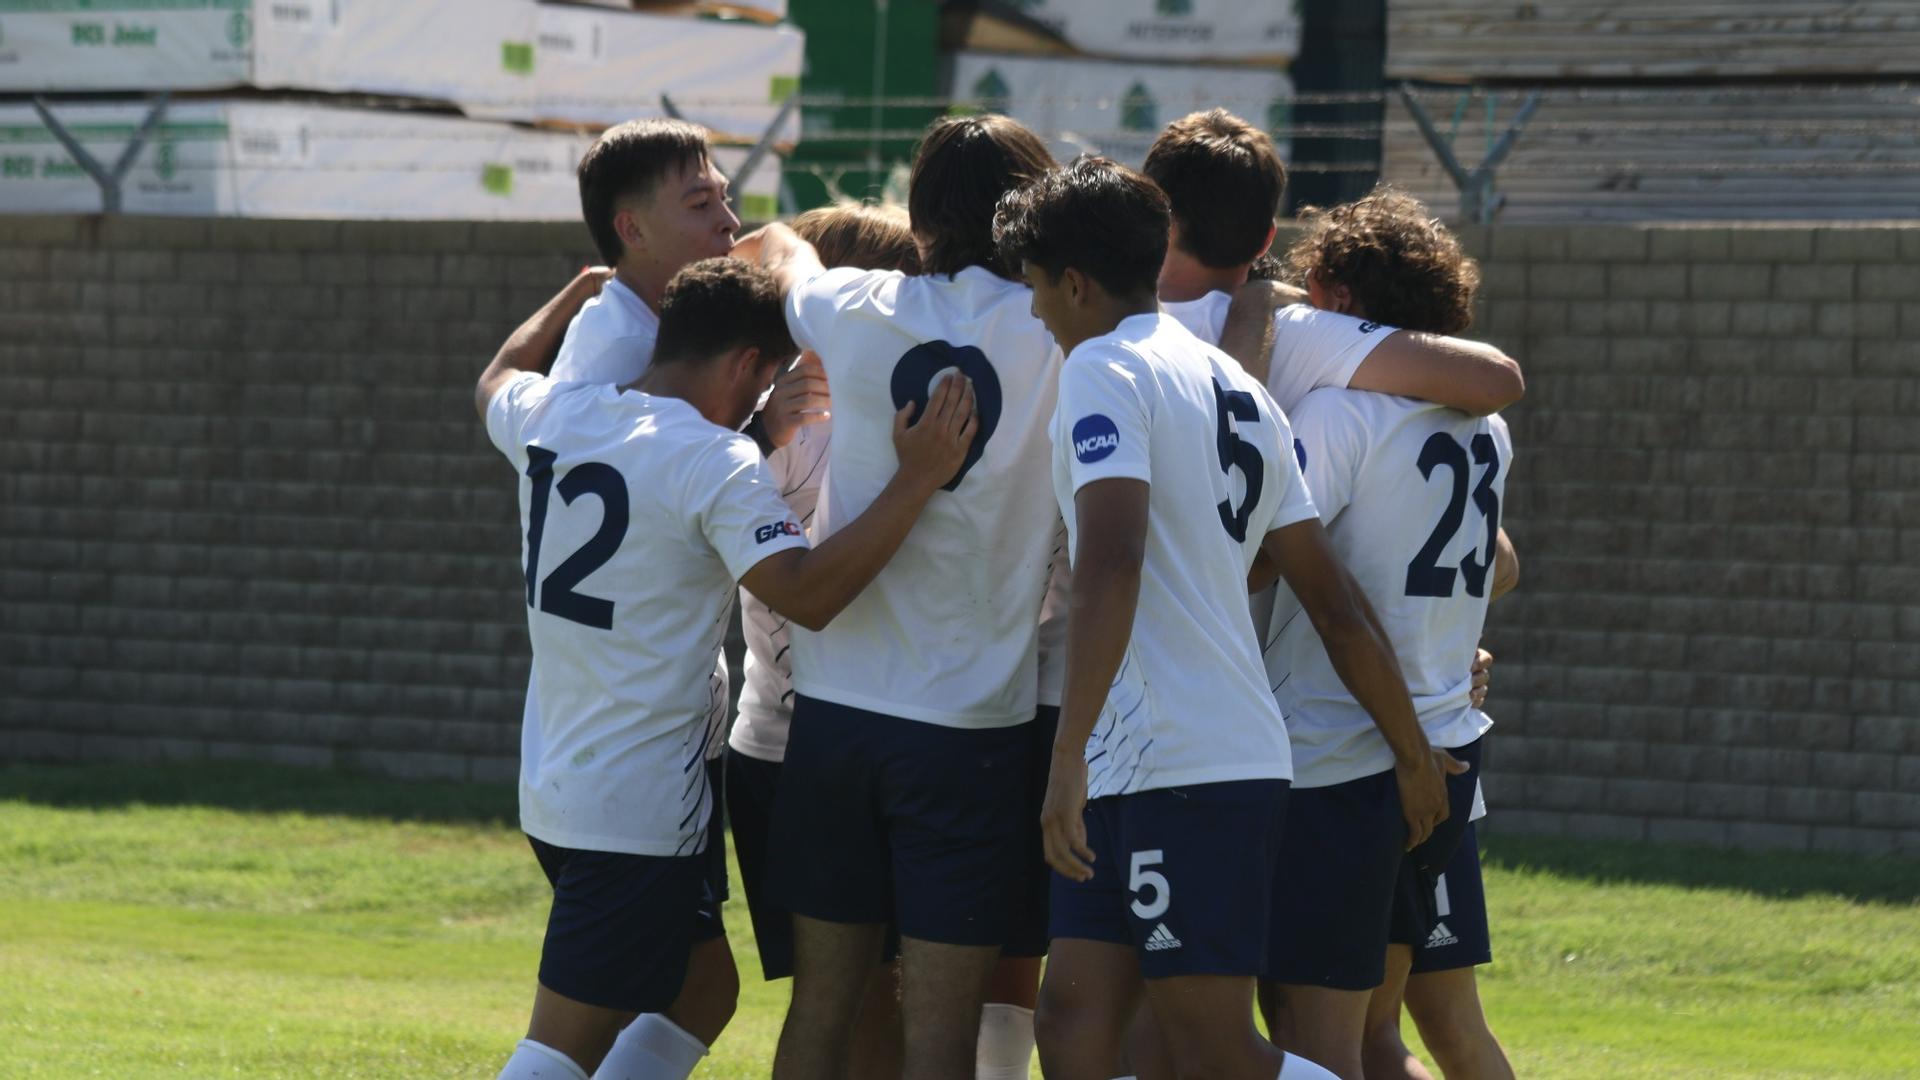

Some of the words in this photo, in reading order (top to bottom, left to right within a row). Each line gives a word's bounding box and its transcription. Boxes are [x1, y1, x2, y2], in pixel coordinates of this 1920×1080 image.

[1076, 433, 1119, 457] NCAA
[1211, 376, 1265, 543] 5
[526, 445, 630, 630] 12
[755, 520, 801, 545] GAC
[1404, 431, 1500, 598] 23
[1129, 849, 1170, 919] 5
[1145, 938, 1182, 952] adidas
